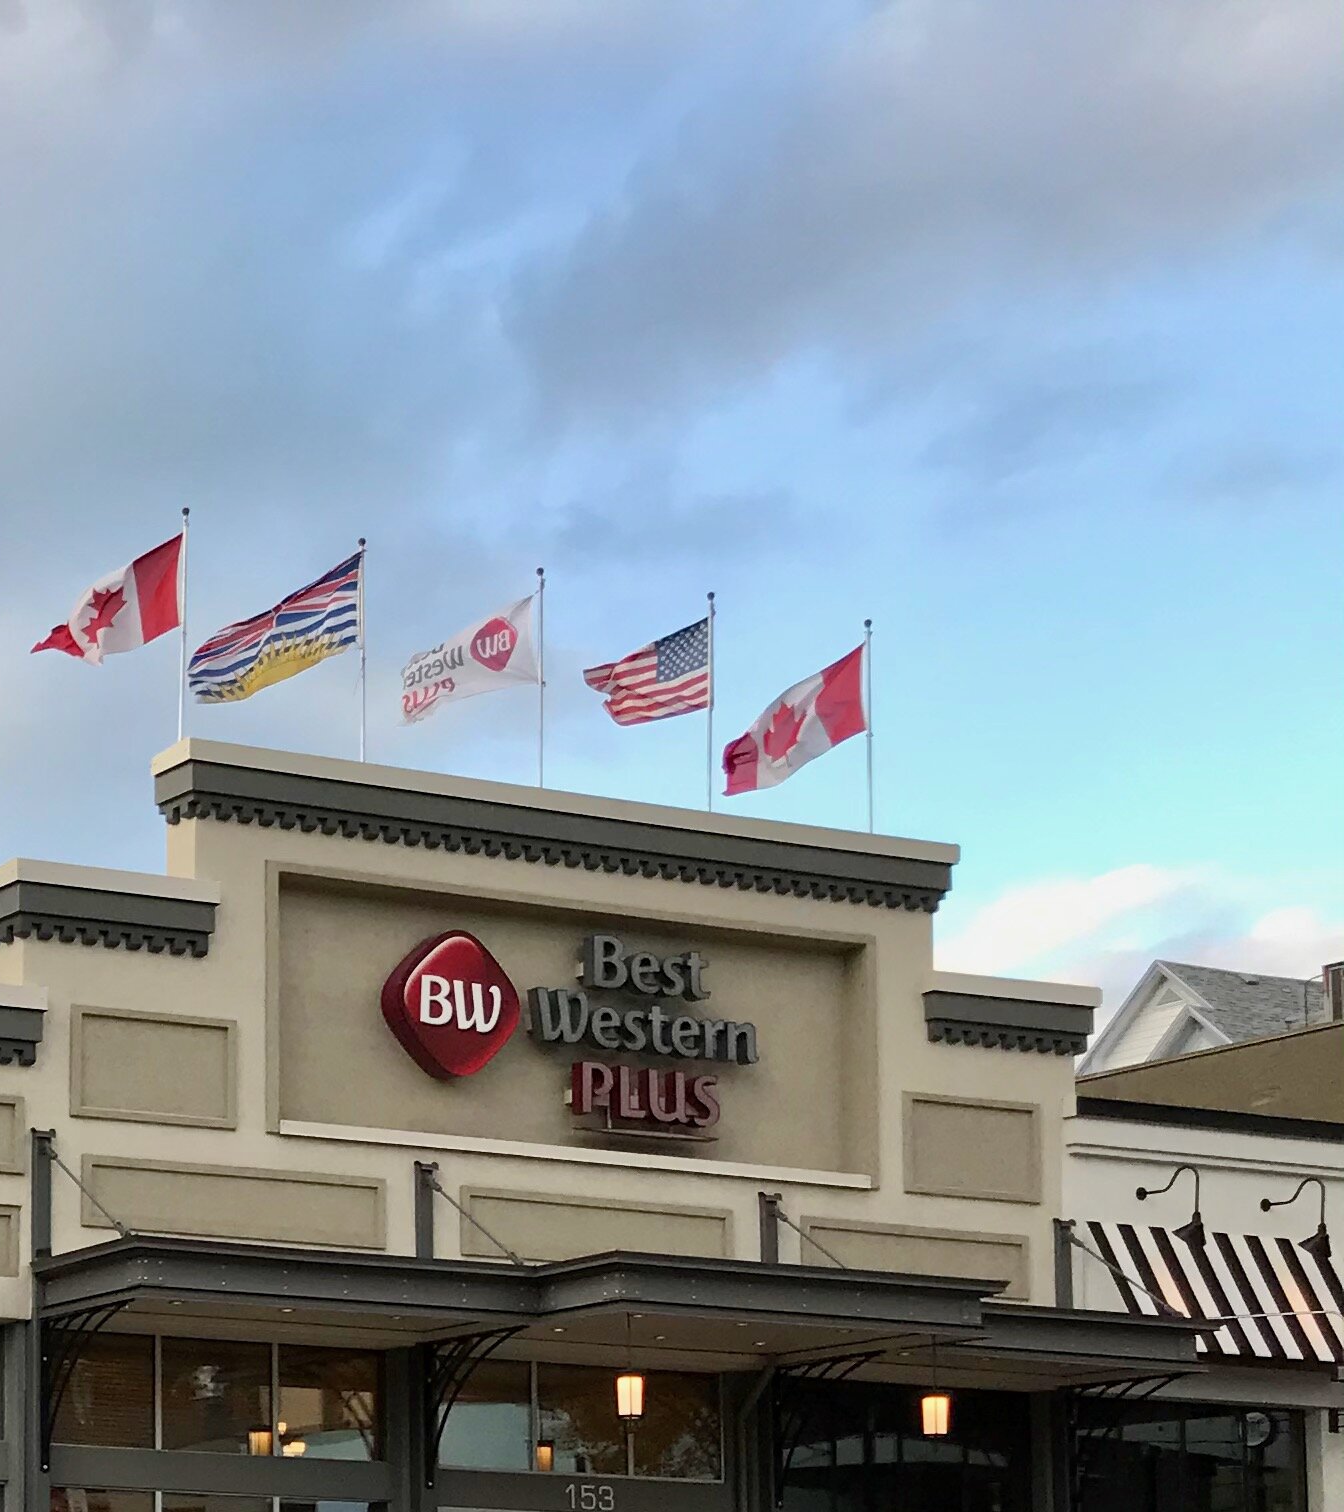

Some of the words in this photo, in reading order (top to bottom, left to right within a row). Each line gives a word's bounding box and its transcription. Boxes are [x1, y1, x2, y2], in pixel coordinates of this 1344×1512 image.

[583, 934, 711, 1000] Best
[419, 974, 502, 1033] BW
[527, 986, 760, 1065] Western
[572, 1061, 720, 1128] PLUS
[565, 1483, 615, 1511] 153
